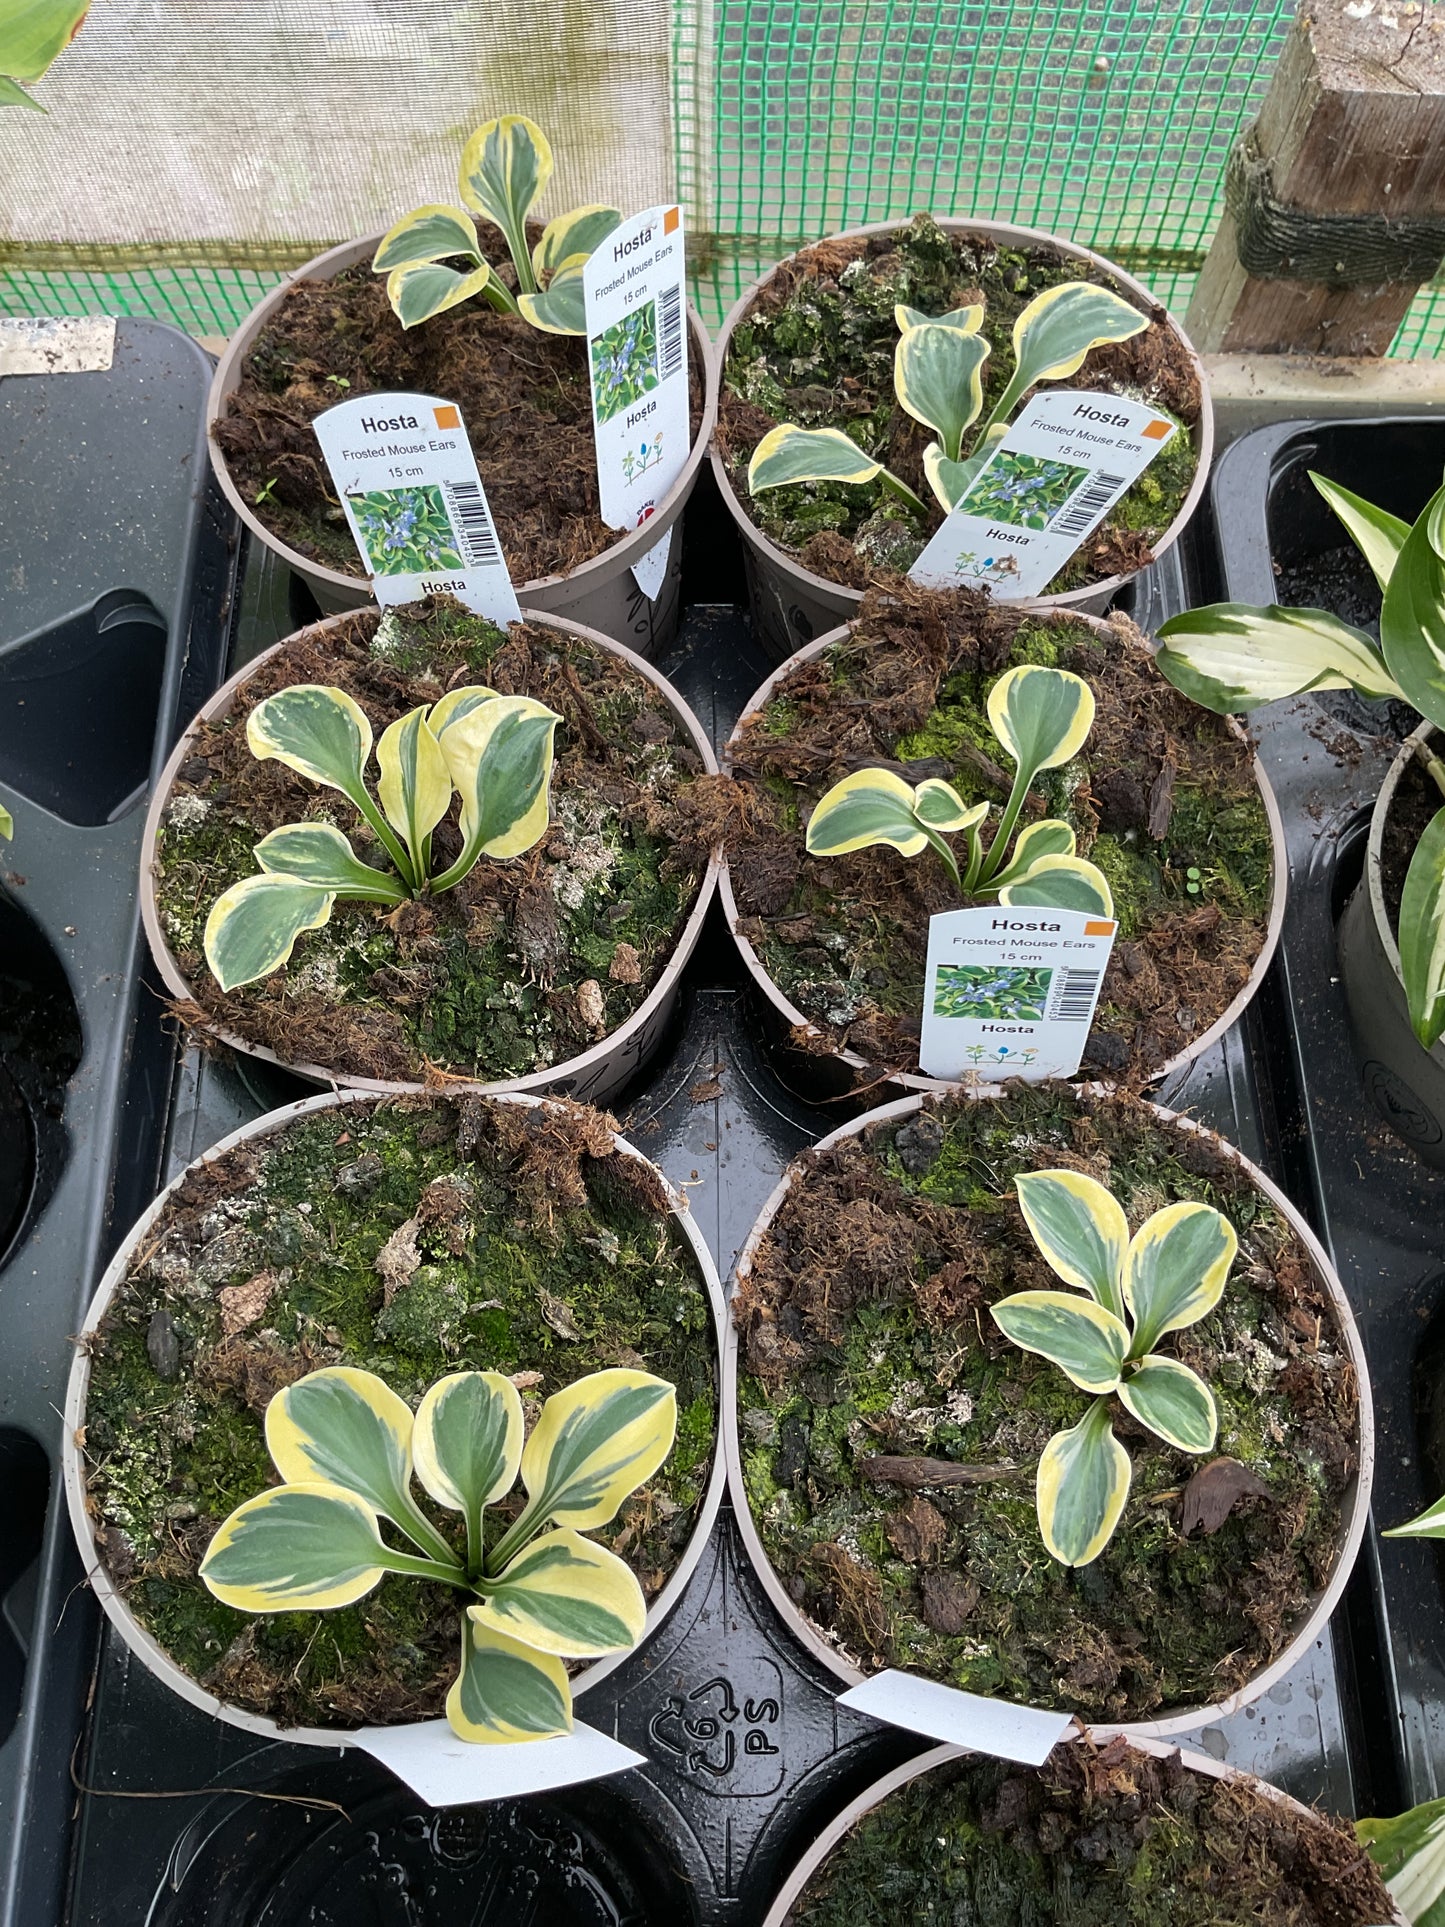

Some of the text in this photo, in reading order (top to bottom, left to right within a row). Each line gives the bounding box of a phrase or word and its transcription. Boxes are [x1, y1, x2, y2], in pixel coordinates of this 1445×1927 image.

[613, 229, 652, 262] Hosta
[595, 245, 673, 300] Frosted Mouse Ears
[624, 284, 647, 305] 15 cm
[361, 414, 419, 434] Hosta
[626, 399, 657, 429] Hosta
[1072, 403, 1131, 429] Hosta
[1030, 419, 1143, 453] Frosted Mouse Ears
[342, 439, 457, 461] Frosted Mouse Ears
[1056, 444, 1091, 460] 15 cm
[388, 466, 424, 479] 15 cm
[985, 528, 1031, 546] Hosta
[421, 579, 467, 594] Hosta
[991, 919, 1061, 932] Hosta
[953, 937, 1096, 949] Frosted Mouse Ears
[1000, 952, 1016, 960] 15
[981, 1024, 1034, 1034] Hosta
[683, 1717, 720, 1740] 6
[743, 1698, 780, 1755] PS
